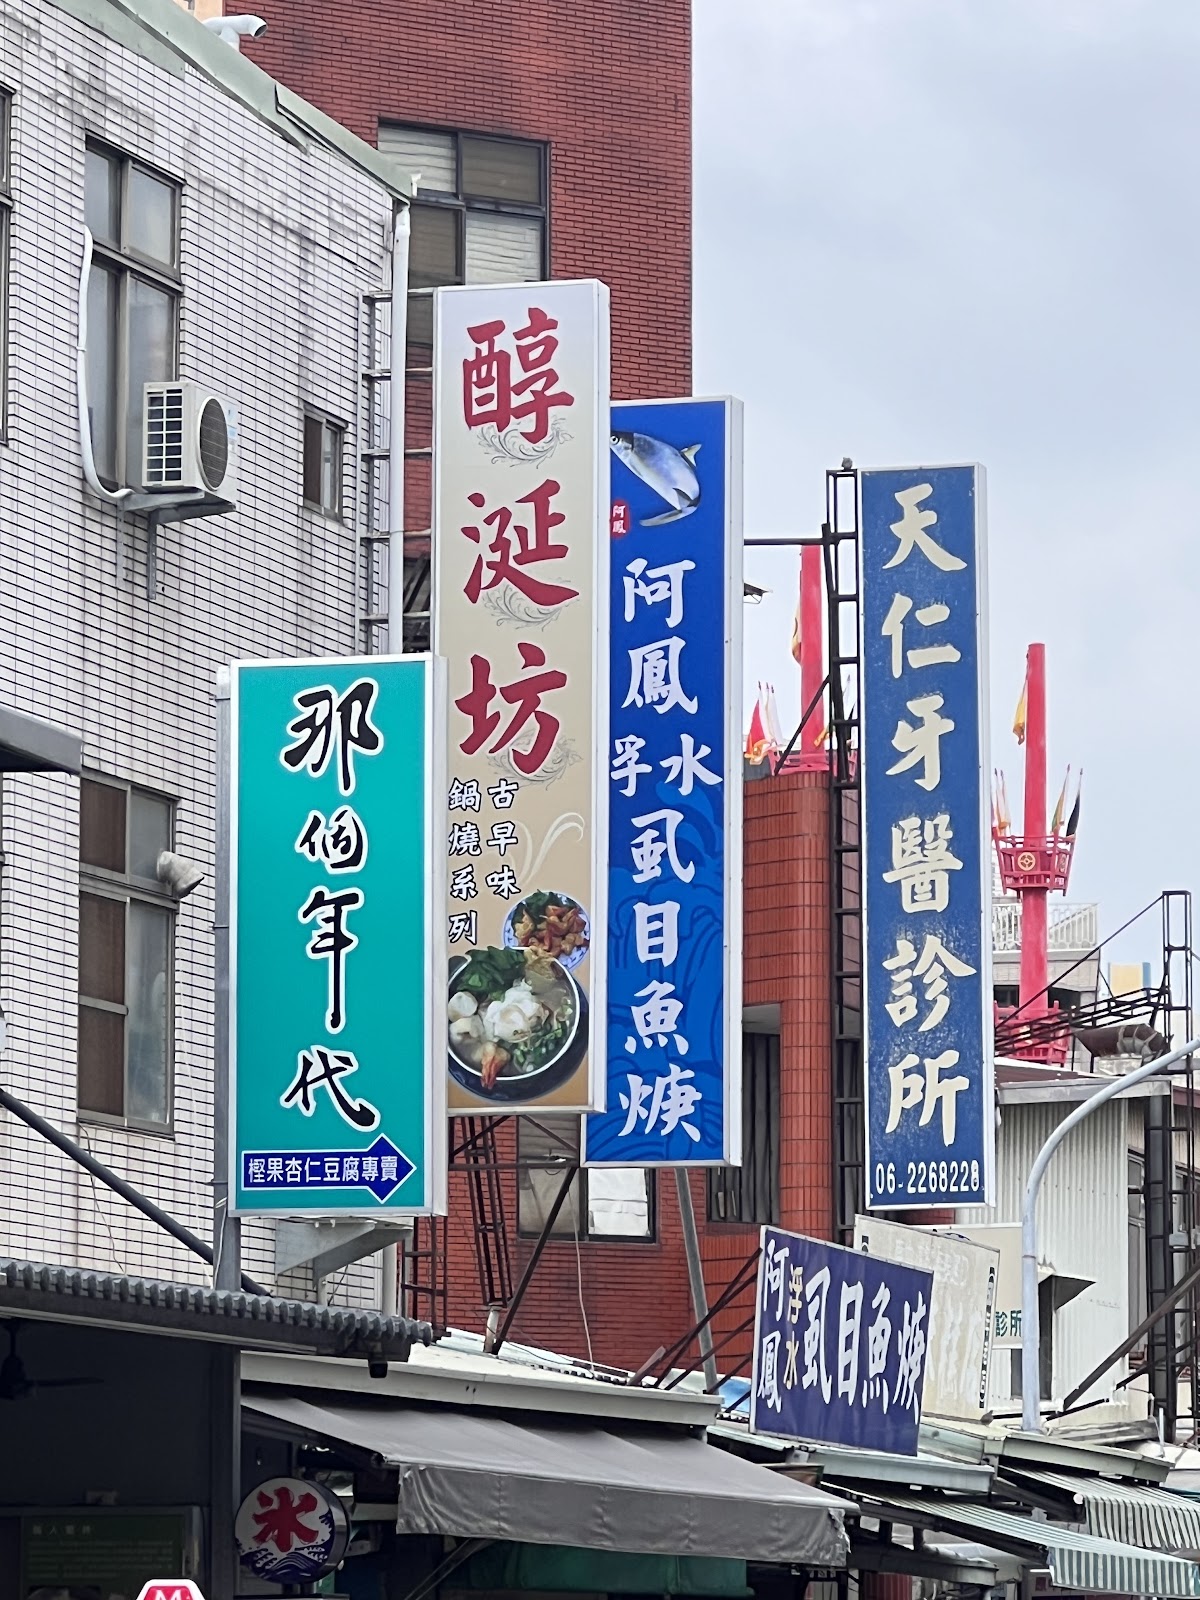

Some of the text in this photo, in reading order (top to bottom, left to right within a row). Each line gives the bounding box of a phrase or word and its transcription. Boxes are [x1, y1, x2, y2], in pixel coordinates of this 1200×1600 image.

[455, 308, 580, 775] 醇涎坊
[612, 505, 627, 534] 阿鳳
[281, 680, 381, 1131] 那個年代
[448, 778, 482, 945] 鍋燒系列
[485, 778, 521, 900] 古早味
[882, 482, 977, 1147] 天仁牙醫診所
